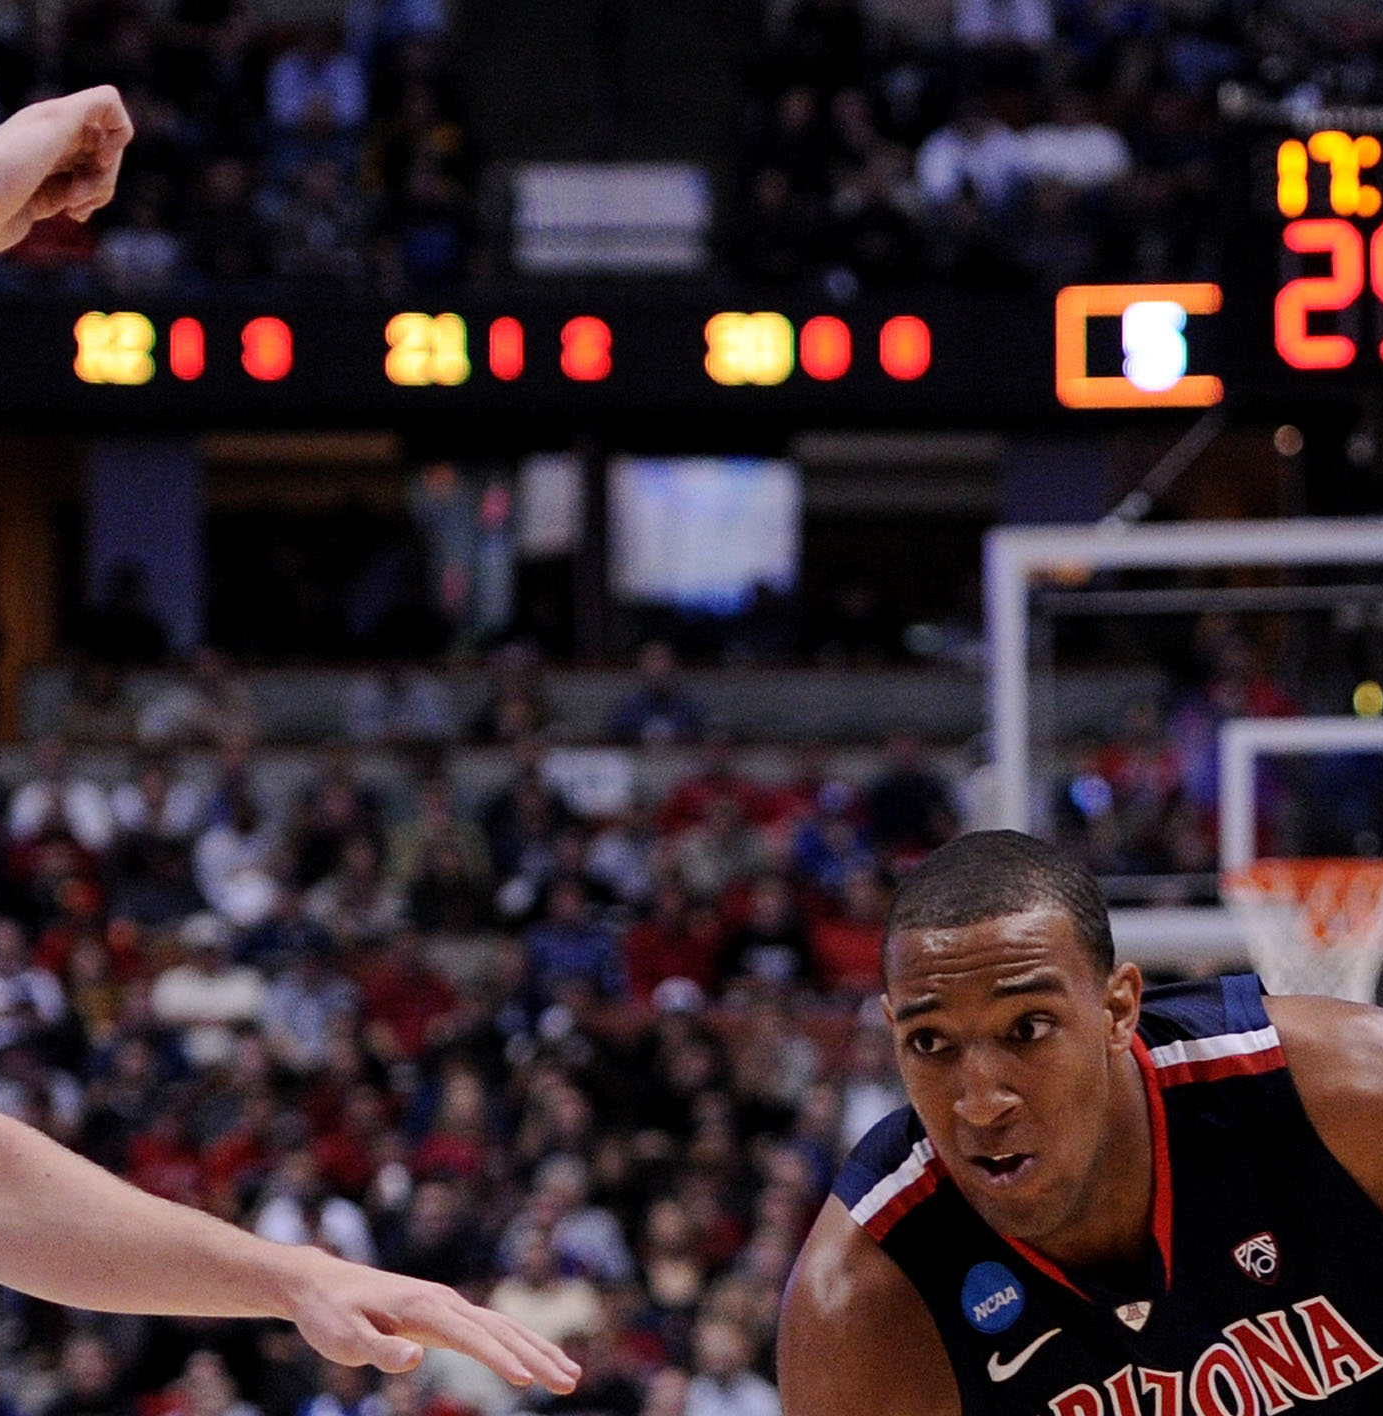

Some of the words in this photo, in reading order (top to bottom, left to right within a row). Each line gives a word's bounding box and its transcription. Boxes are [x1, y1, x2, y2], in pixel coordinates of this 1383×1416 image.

[1233, 1234, 1277, 1271] PAC
[1250, 1254, 1276, 1278] 10
[972, 1284, 1019, 1322] NCAA
